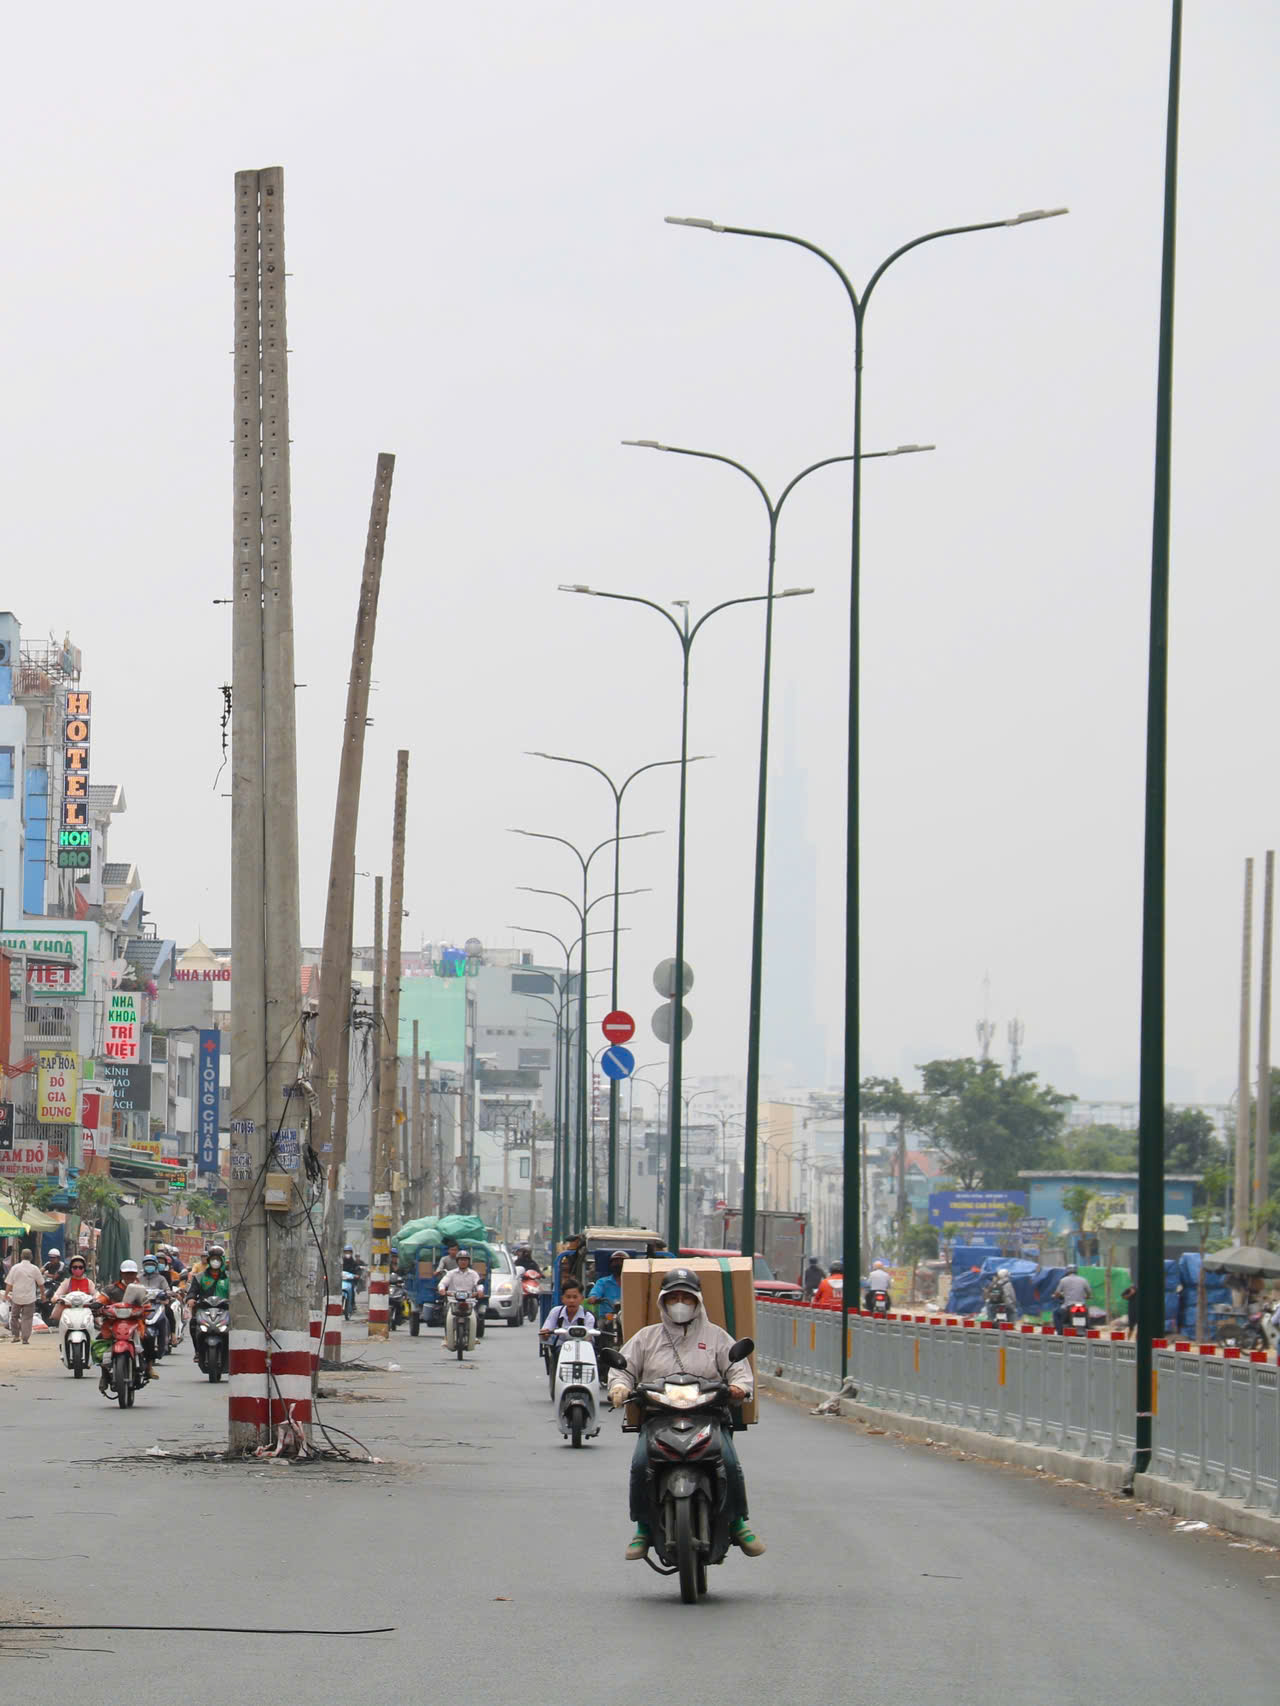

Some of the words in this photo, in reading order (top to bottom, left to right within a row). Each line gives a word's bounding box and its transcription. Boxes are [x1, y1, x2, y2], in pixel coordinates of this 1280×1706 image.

[65, 693, 89, 825] HOTEL
[59, 831, 89, 847] HOA
[175, 969, 199, 981] NHA
[203, 969, 231, 981] KHO
[111, 995, 134, 1008] NHA
[108, 1010, 137, 1023] KHOA
[110, 1023, 134, 1039] TRÍ
[105, 1040, 137, 1060] VIỆT
[203, 1056, 216, 1105] LONG
[47, 1091, 67, 1103] GIA
[202, 1109, 216, 1162] CHÂU
